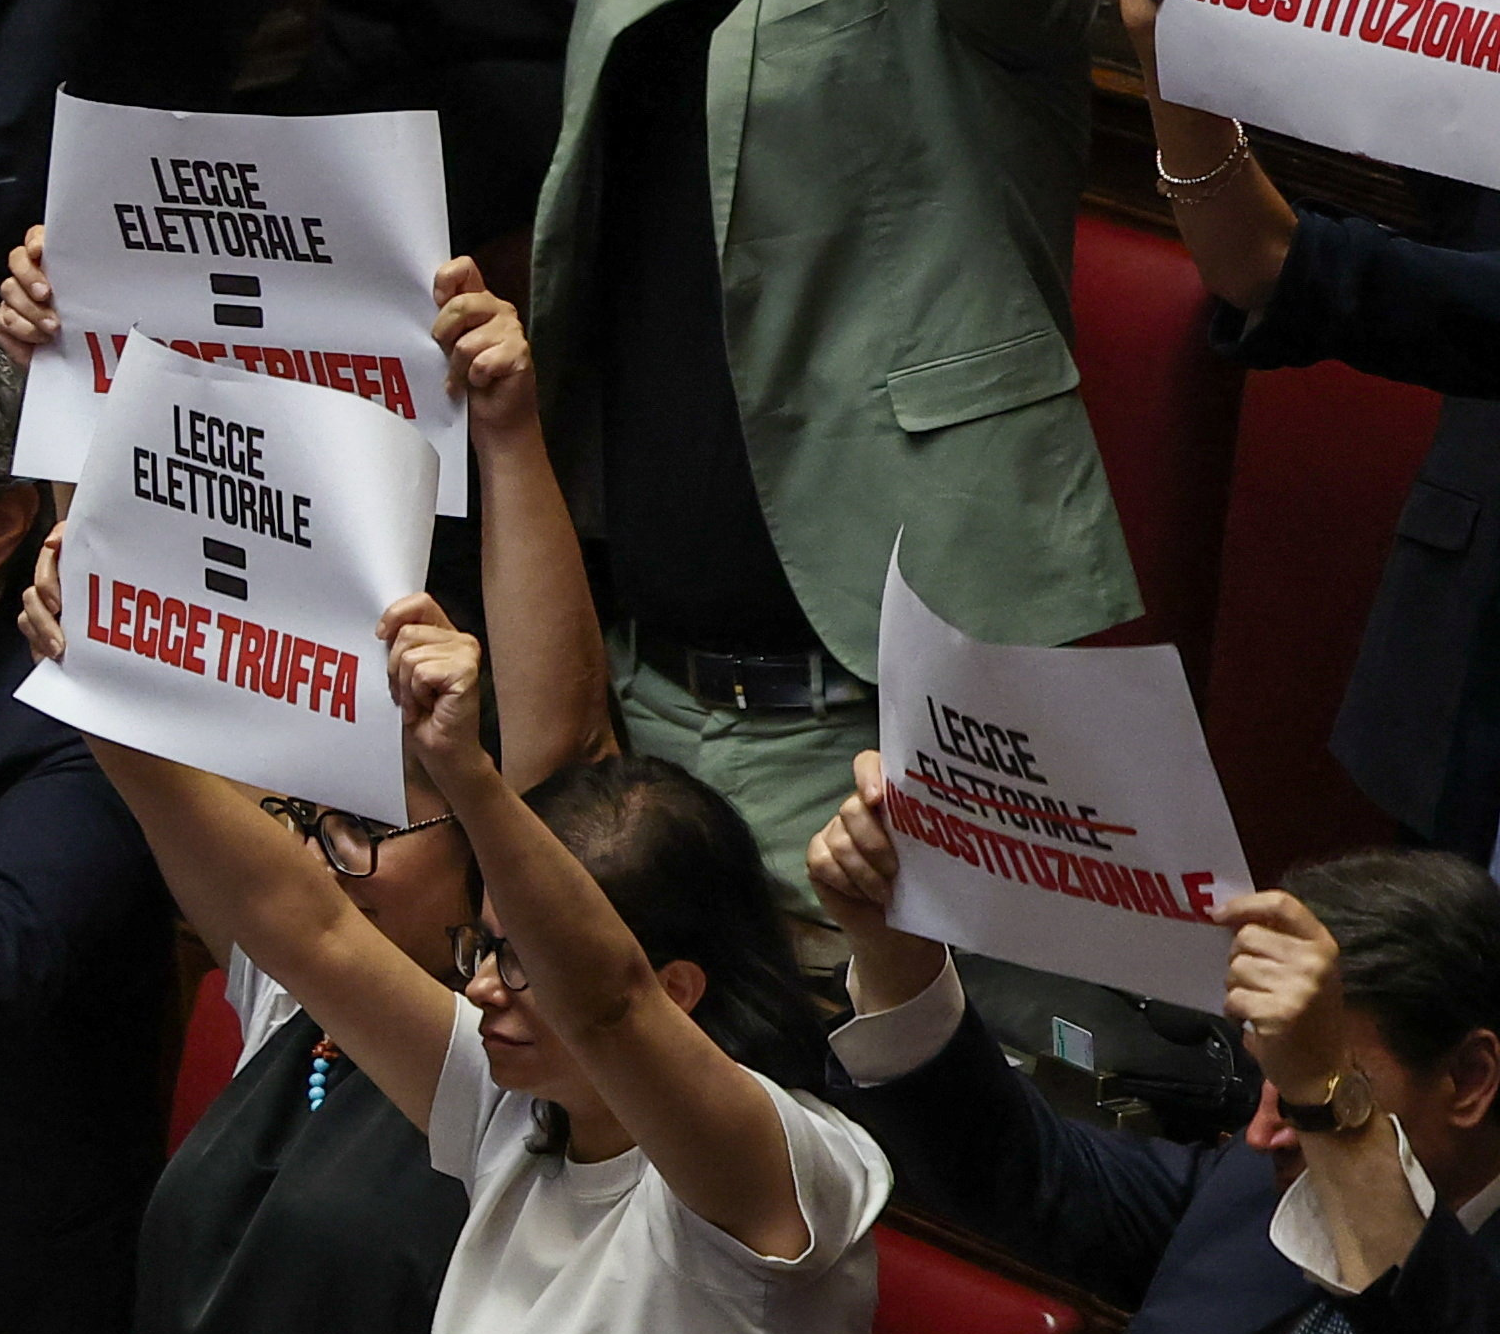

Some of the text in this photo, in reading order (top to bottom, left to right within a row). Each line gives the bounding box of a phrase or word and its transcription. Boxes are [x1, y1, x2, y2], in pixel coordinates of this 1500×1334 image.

[150, 156, 266, 210] LEGGE
[112, 203, 333, 265] ELETTORALE
[173, 404, 266, 481] LEGGE
[133, 446, 312, 549] ELETTORALE
[87, 573, 359, 724] LEGGE TRUFFA
[926, 695, 1048, 785] LEGGE
[916, 750, 1112, 851] ELETTORALE
